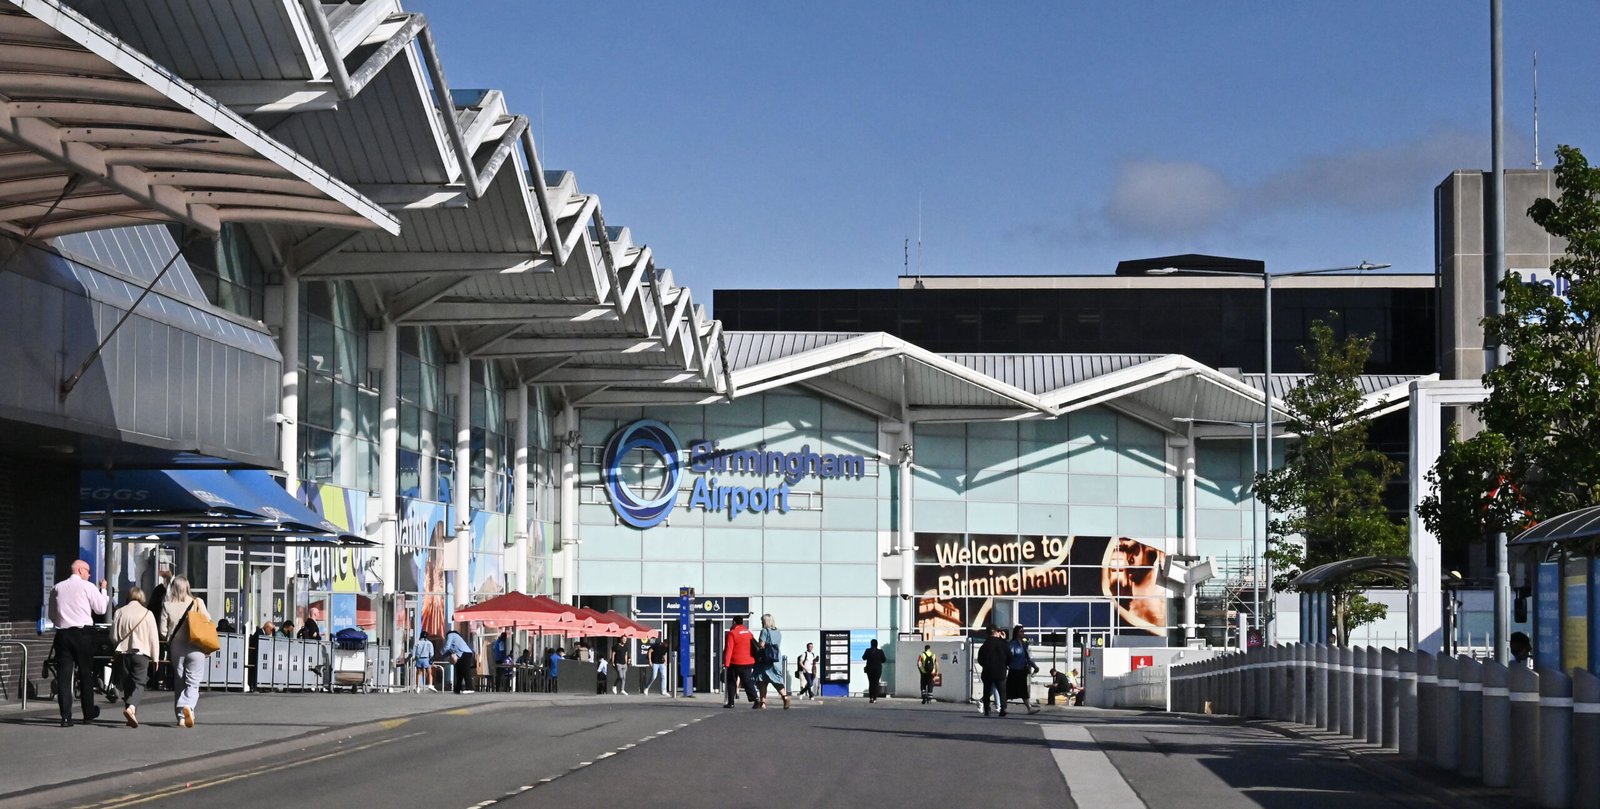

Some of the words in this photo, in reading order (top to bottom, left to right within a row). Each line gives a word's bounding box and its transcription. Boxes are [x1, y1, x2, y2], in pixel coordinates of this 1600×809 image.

[691, 441, 864, 486] Birmingham
[80, 488, 149, 500] EGGS
[690, 476, 790, 519] Airport
[935, 540, 1035, 568] Welcome
[1041, 535, 1062, 558] to
[938, 568, 1067, 600] Birmingham
[952, 656, 958, 664] A
